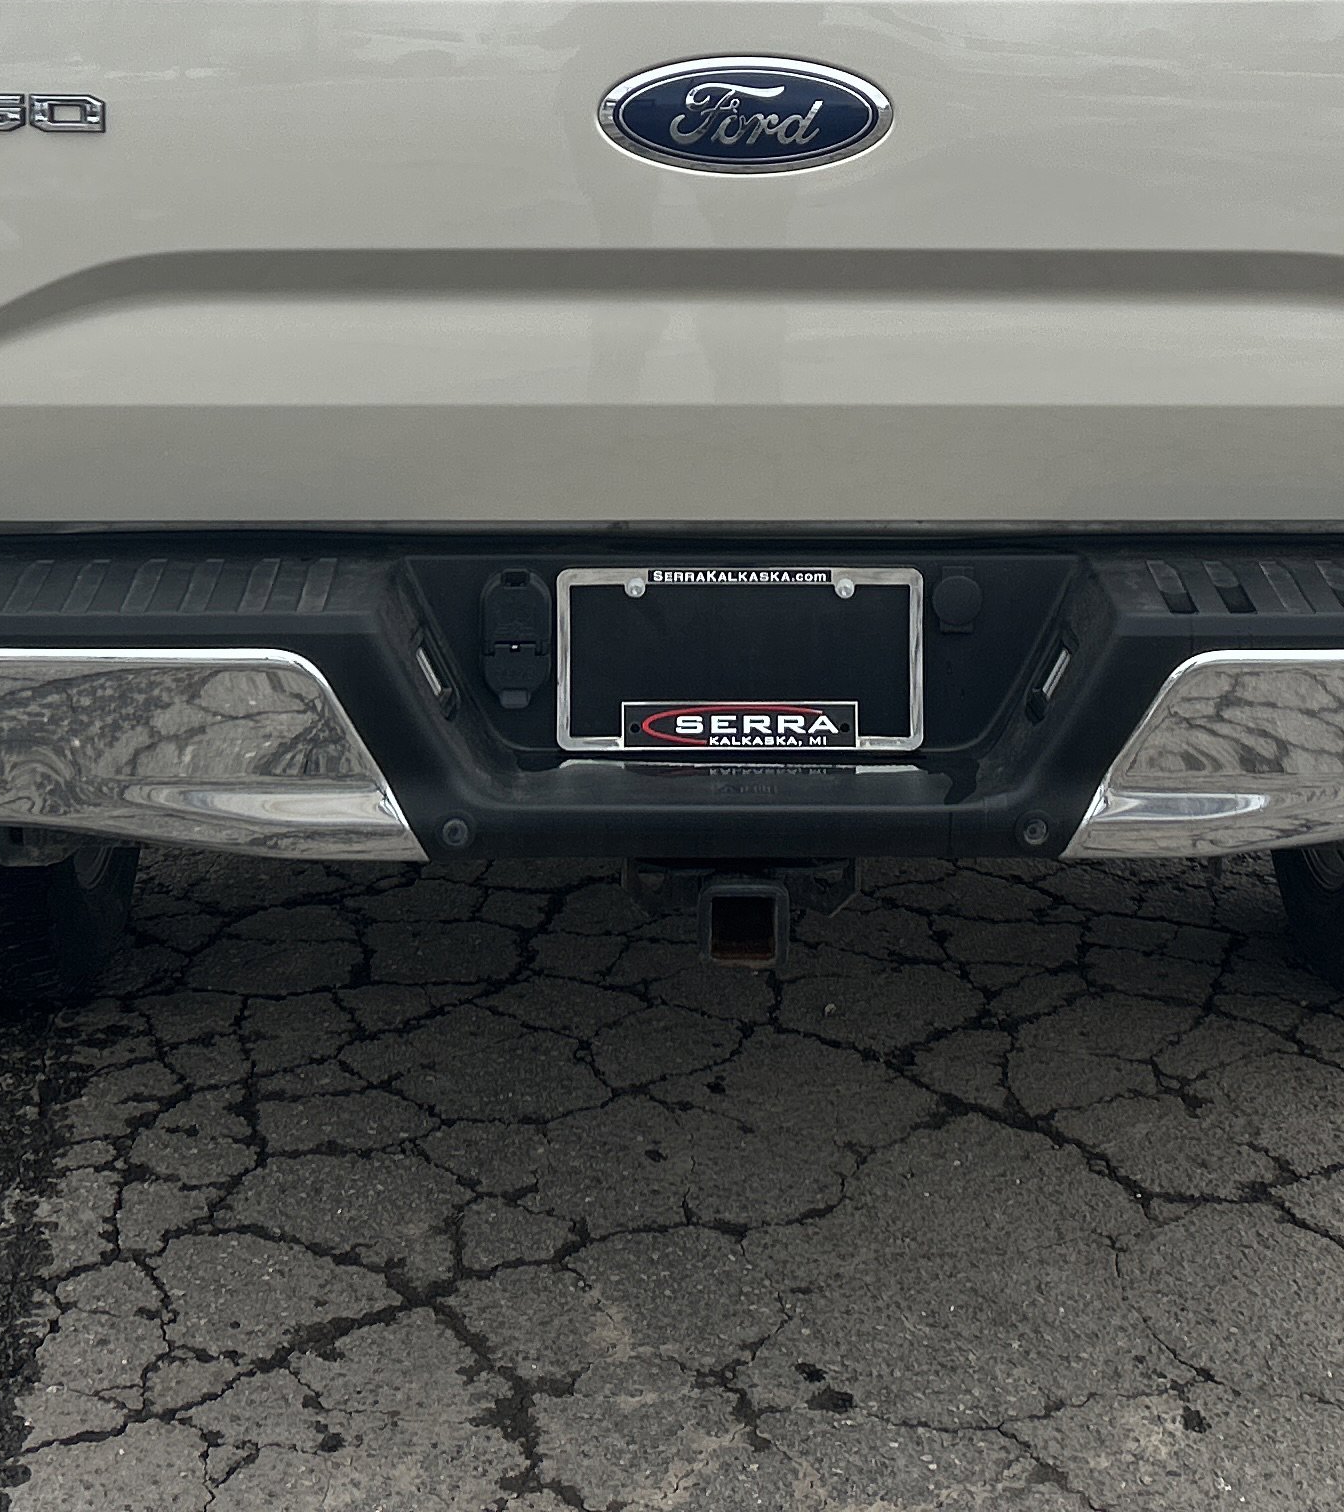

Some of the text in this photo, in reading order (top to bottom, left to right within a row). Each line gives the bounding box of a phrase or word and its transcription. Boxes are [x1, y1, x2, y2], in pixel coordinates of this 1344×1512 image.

[669, 82, 824, 145] Ford
[675, 715, 839, 734] SERRA
[709, 736, 827, 747] KALKASKA, MI
